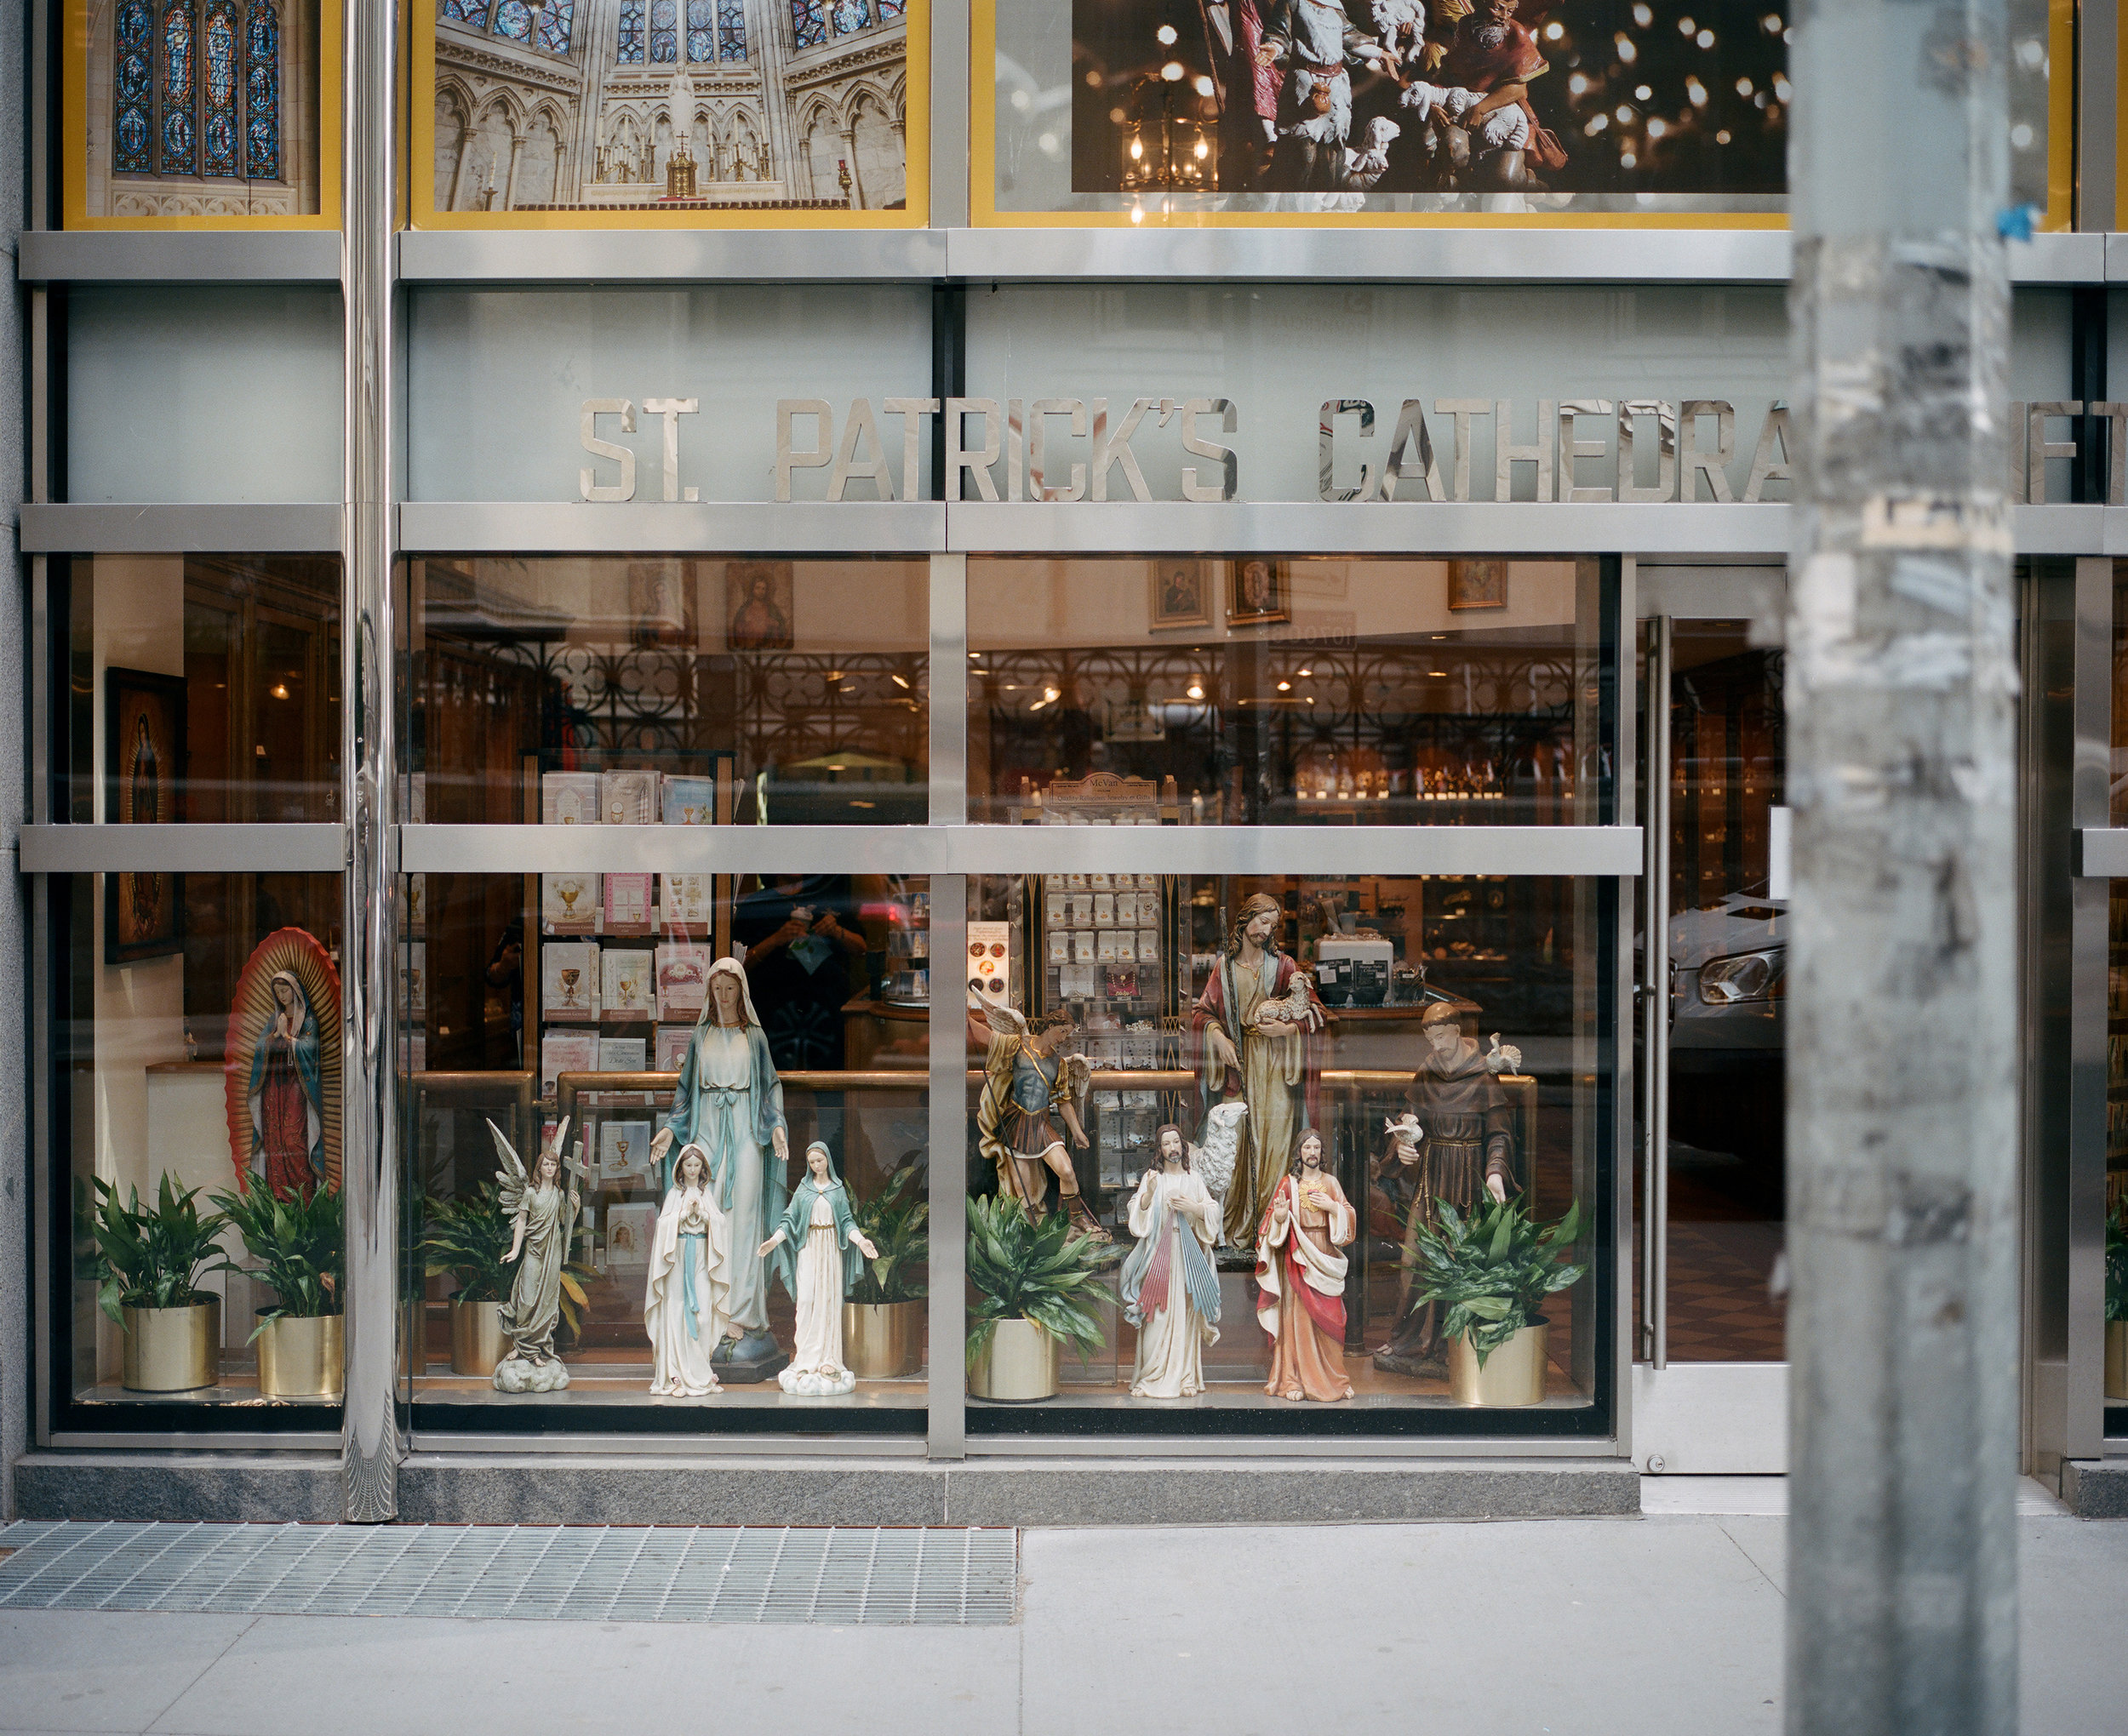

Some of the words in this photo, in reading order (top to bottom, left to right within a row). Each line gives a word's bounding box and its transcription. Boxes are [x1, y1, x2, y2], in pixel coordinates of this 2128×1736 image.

[580, 397, 700, 501] ST.
[775, 397, 1238, 502] PATRICK'S
[1318, 398, 1793, 504] CATHEDRA
[2010, 399, 2128, 505] IFT
[1090, 779, 1118, 787] McVan
